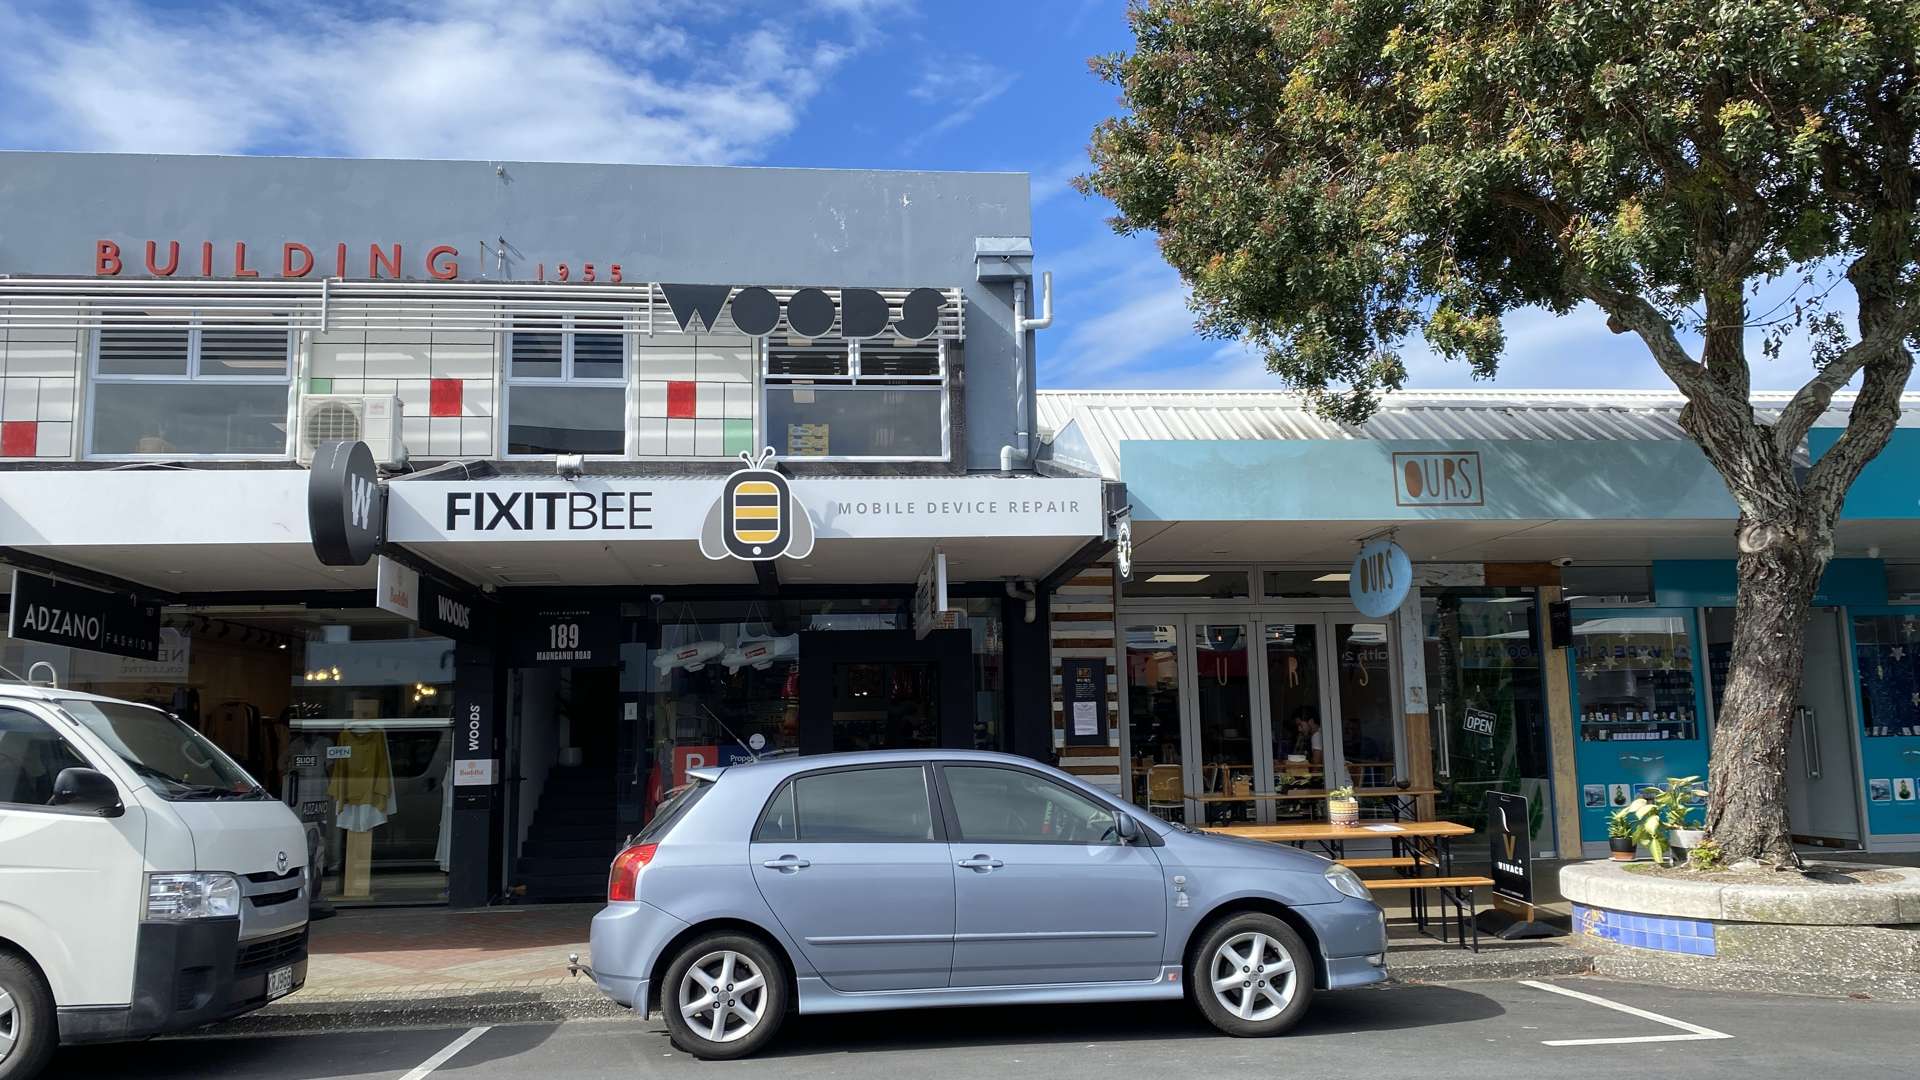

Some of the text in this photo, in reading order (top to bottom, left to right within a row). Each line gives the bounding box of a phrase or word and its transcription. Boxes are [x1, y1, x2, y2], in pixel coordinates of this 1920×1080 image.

[95, 240, 622, 282] BUILDING 1955
[657, 282, 949, 341] WOODS
[1404, 458, 1472, 500] OURS
[351, 472, 373, 530] W
[446, 491, 653, 531] FIXITBEE
[838, 500, 1081, 515] MOBILE DEVICE REPAIR
[1360, 549, 1394, 594] OURS
[22, 603, 100, 641] ADZANO
[437, 594, 471, 630] WOODS
[549, 623, 579, 649] 189
[574, 650, 592, 660] ROAD
[468, 704, 481, 751] WOODS
[1466, 716, 1494, 733] OPEN
[296, 756, 316, 764] SLIDE
[328, 748, 350, 757] OPEN
[1497, 861, 1524, 876] VIVACE
